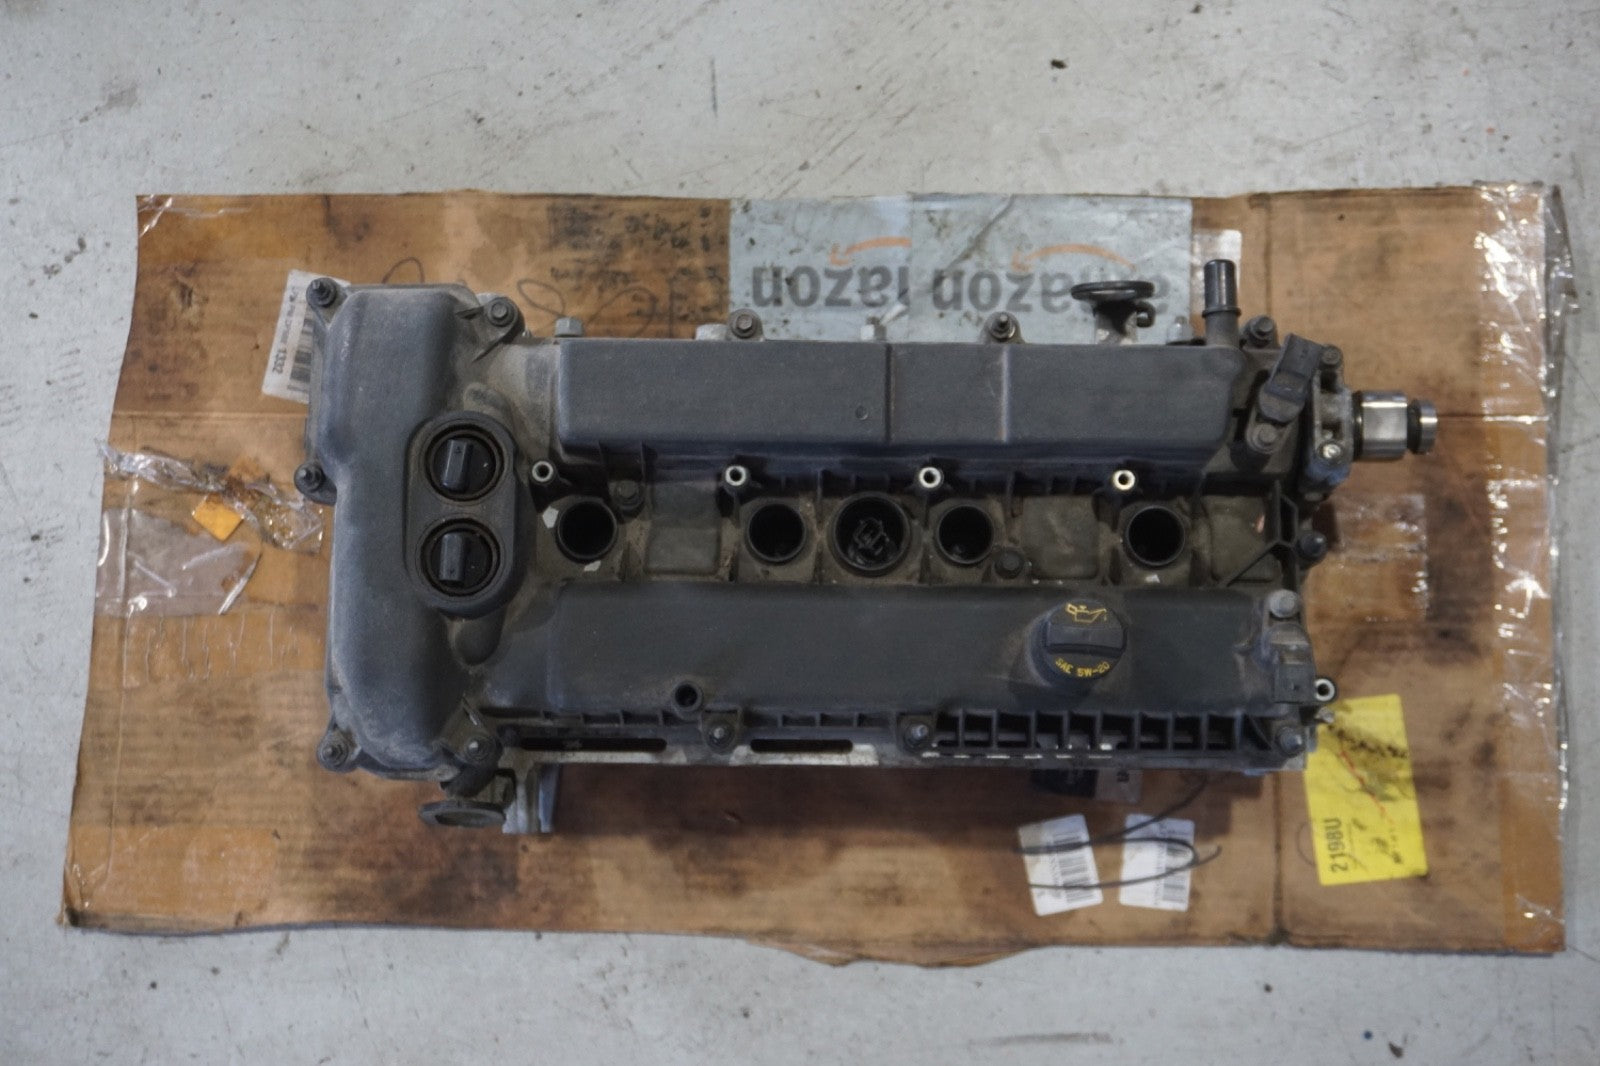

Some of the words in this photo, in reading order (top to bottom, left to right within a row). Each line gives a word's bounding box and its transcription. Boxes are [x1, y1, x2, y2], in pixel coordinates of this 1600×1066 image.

[752, 264, 911, 308] azon
[932, 266, 1172, 315] aazon
[1055, 658, 1074, 674] SAE
[1076, 661, 1111, 678] 5W-20
[1323, 818, 1348, 872] 2198U
